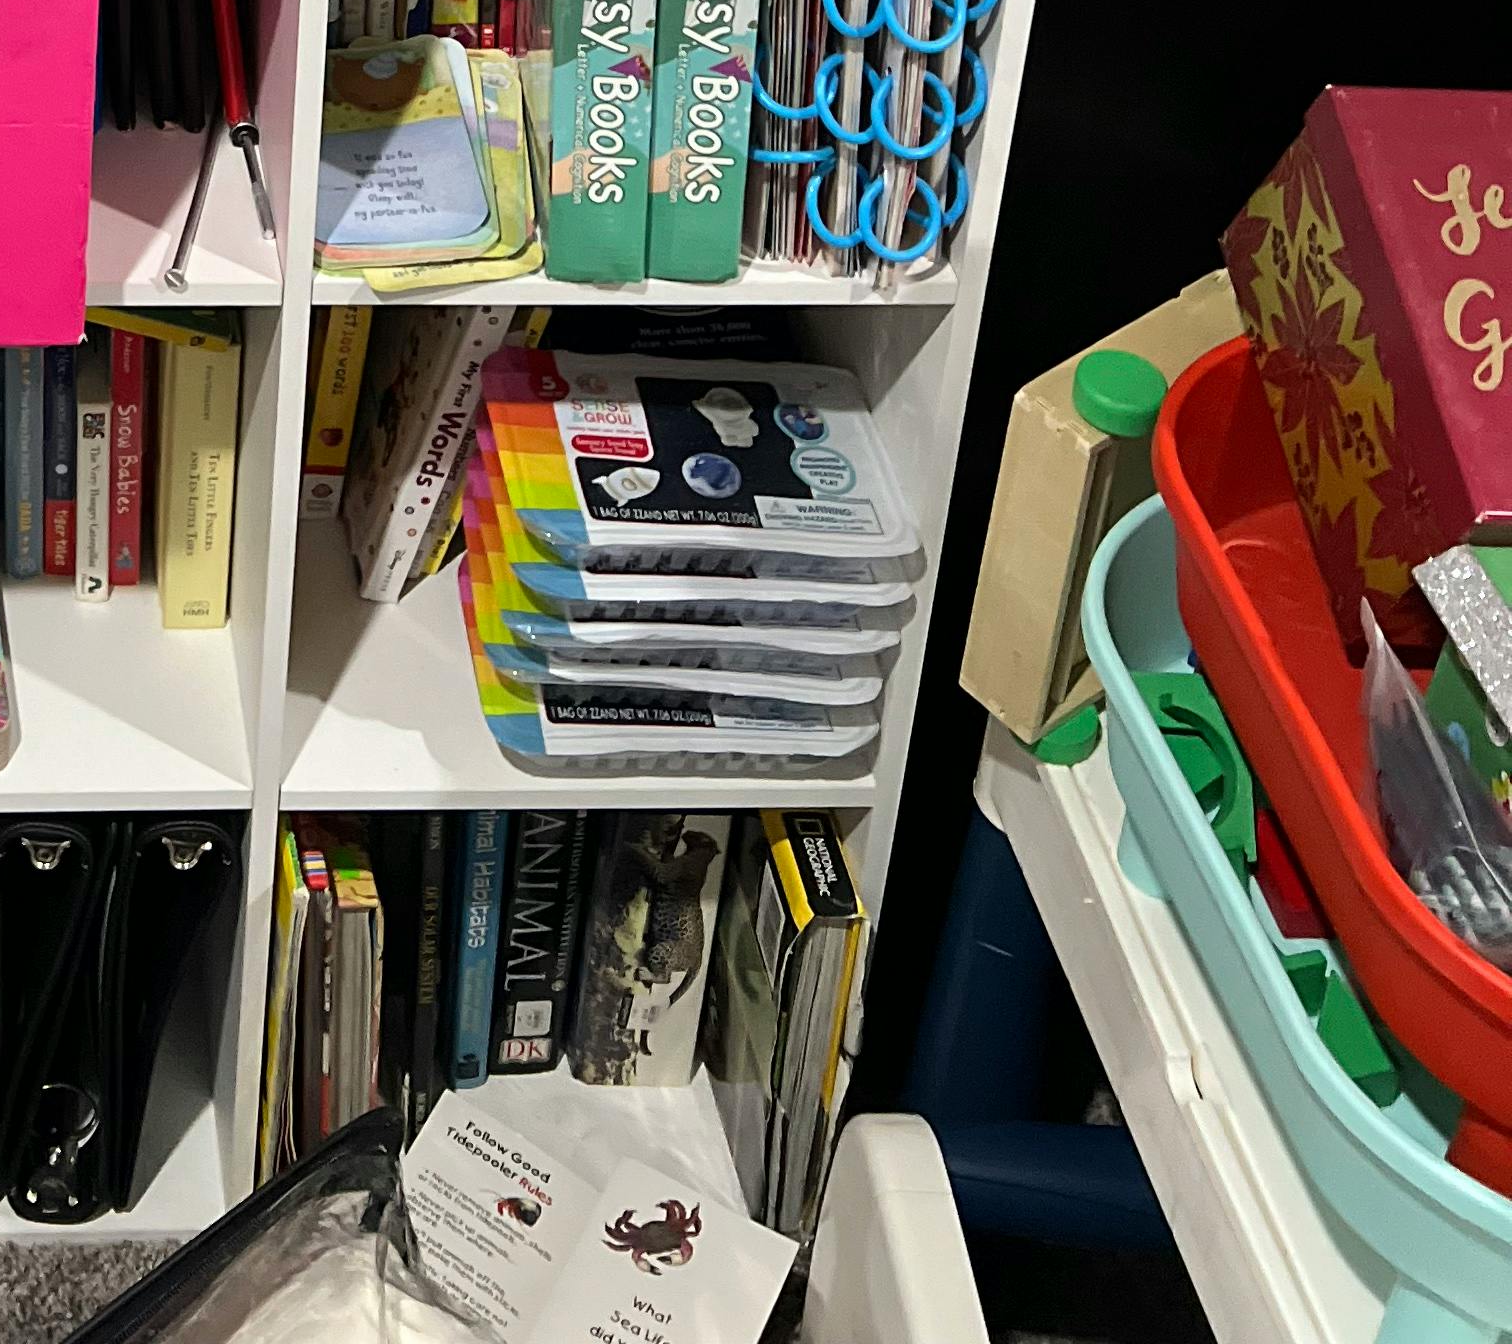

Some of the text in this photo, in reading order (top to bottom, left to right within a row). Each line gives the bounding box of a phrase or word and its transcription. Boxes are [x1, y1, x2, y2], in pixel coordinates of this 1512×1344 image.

[586, 73, 642, 205] Books
[683, 72, 739, 205] Books
[451, 358, 480, 409] My First
[115, 404, 138, 514] Snow Babies
[413, 405, 466, 493] Words
[800, 835, 831, 899] GEOGRAPHIC
[812, 835, 838, 884] NATIONAL
[466, 860, 494, 949] Habitats
[504, 812, 567, 993] ANIMAL
[502, 1038, 550, 1063] DK
[443, 1124, 556, 1208] Tidepooler Rules
[464, 1119, 552, 1185] Follow Good
[633, 1295, 672, 1324] What
